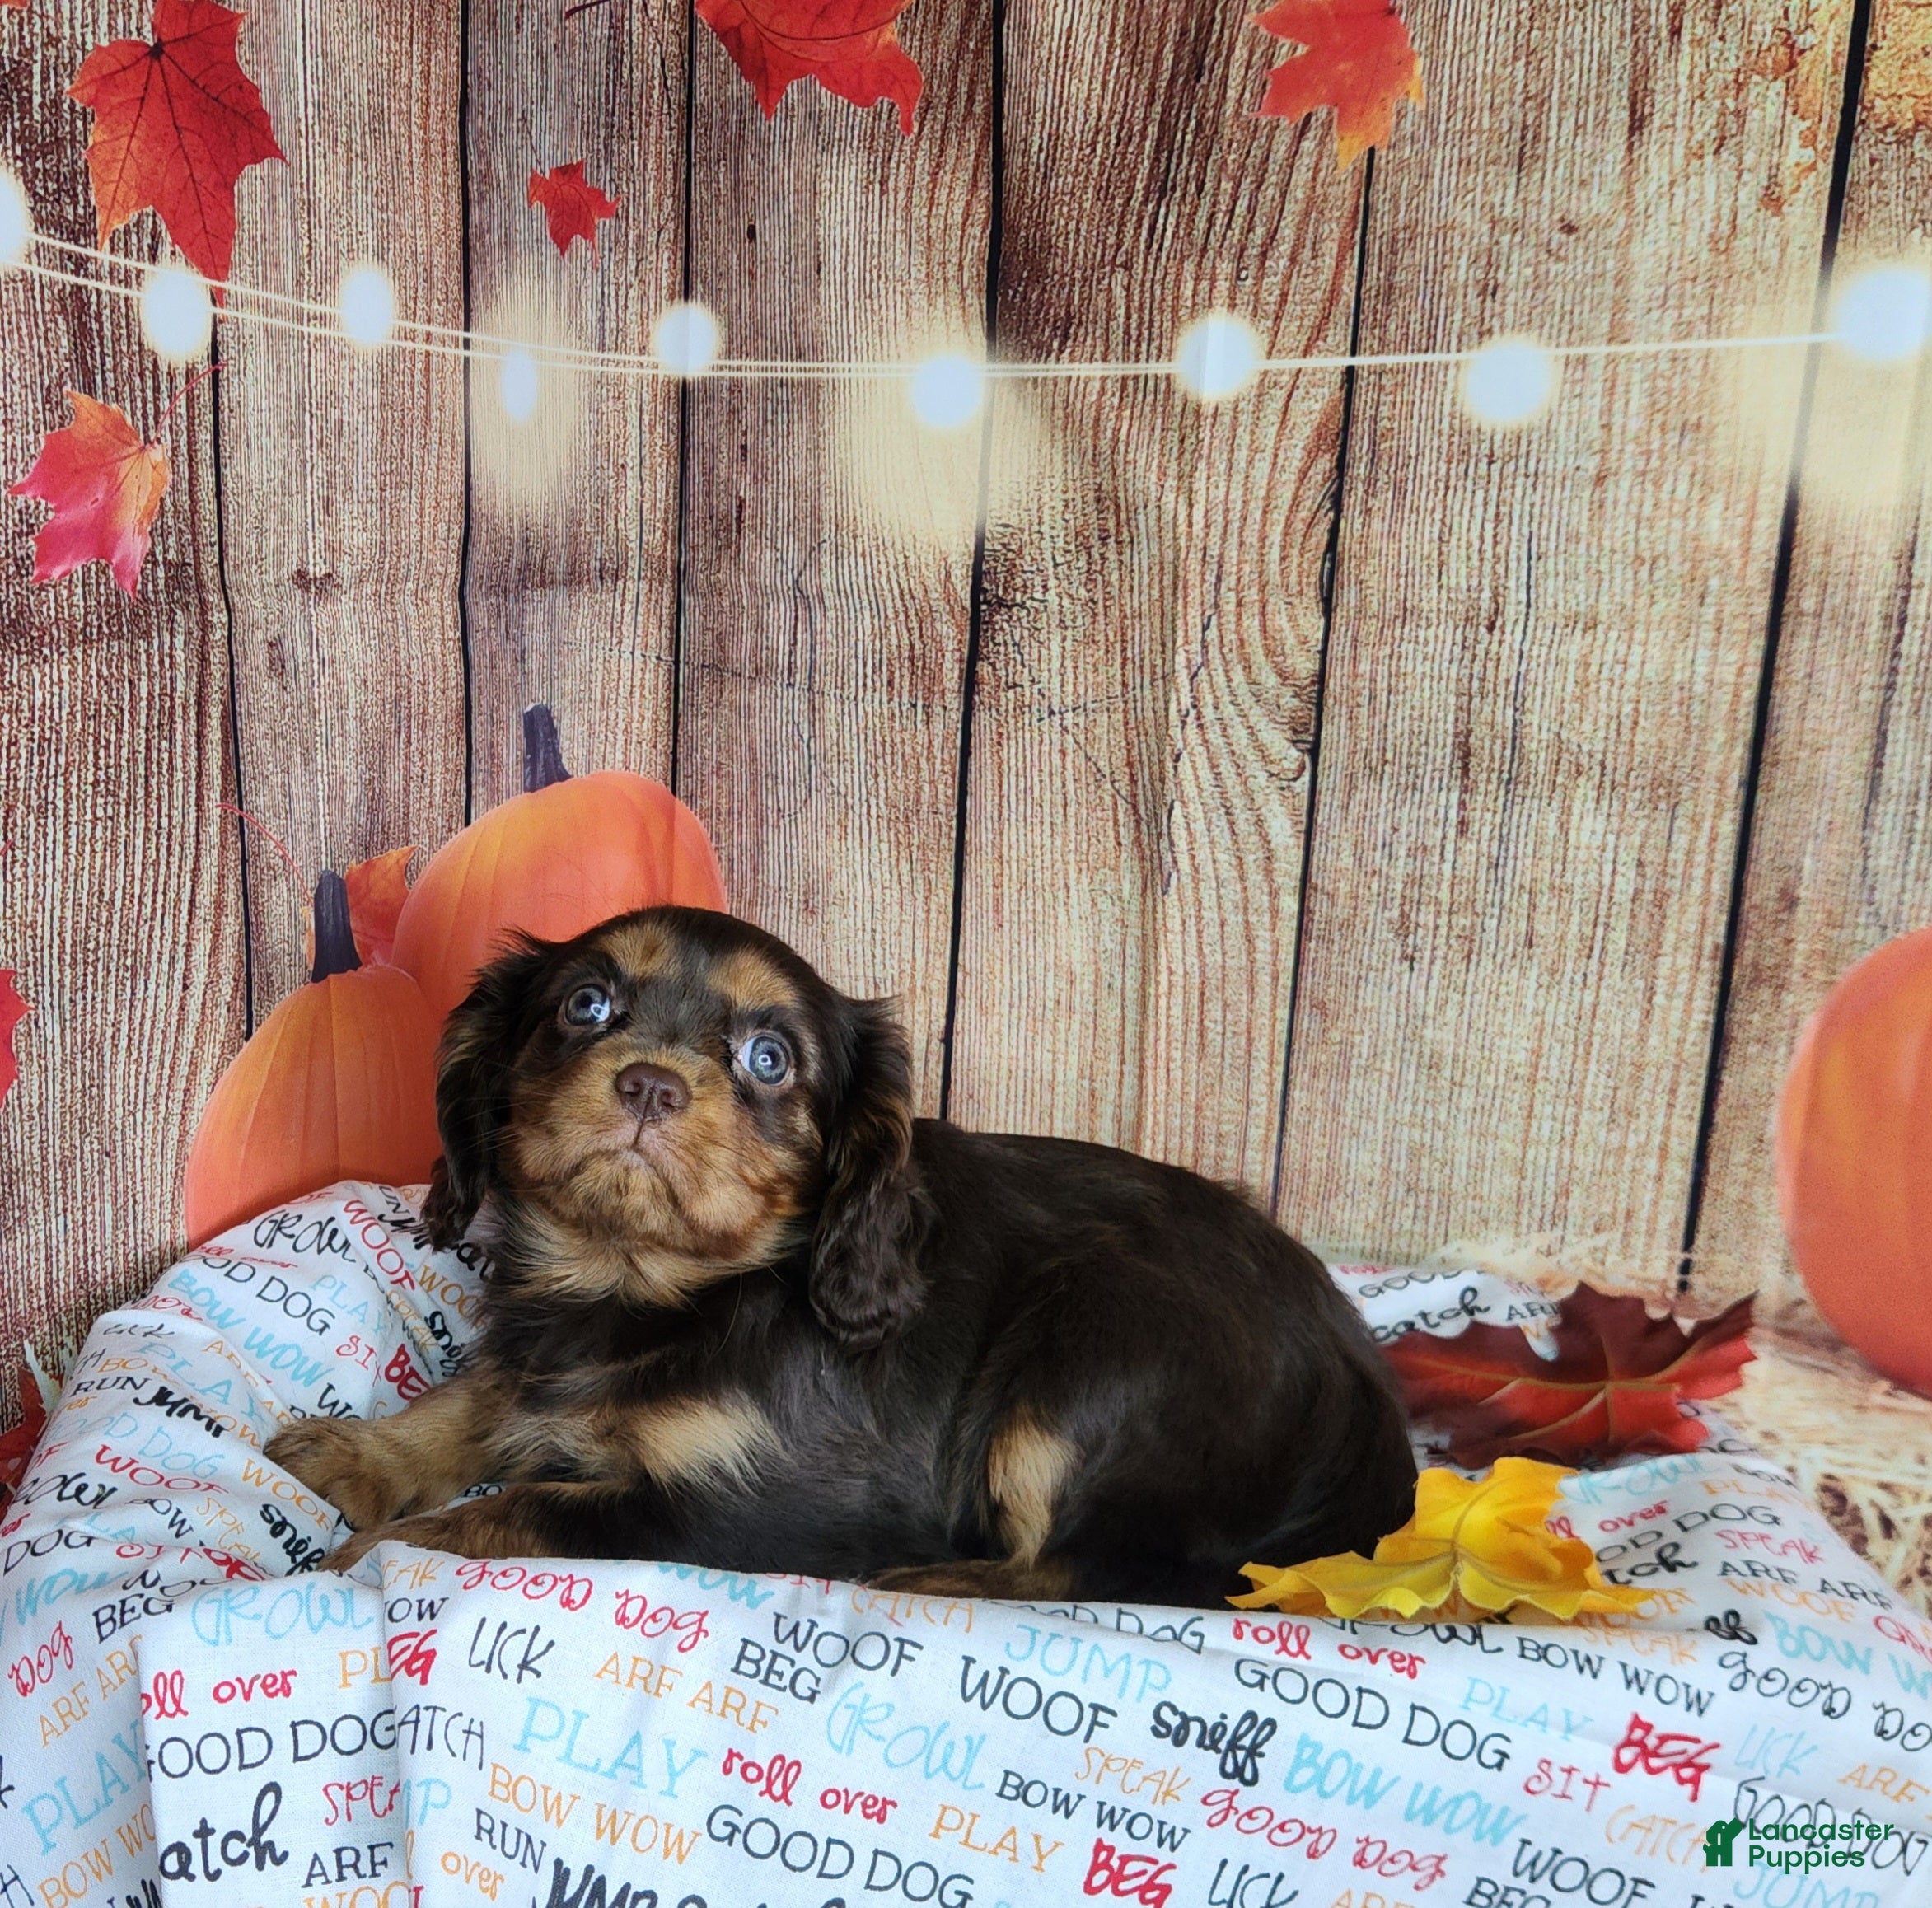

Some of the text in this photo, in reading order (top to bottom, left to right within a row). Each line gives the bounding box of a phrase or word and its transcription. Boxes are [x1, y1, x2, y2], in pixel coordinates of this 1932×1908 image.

[344, 1200, 415, 1291] WOOF
[168, 1269, 246, 1329] BOW
[244, 1327, 336, 1387] WOW
[255, 1276, 336, 1336] DOG
[70, 1377, 152, 1396] RUN
[385, 1343, 430, 1400] BE
[95, 1444, 229, 1494] WOOF
[138, 1426, 225, 1479] DOG
[3, 1529, 99, 1577] DOG
[1595, 1503, 1783, 1563] OD DOG
[1602, 1542, 1699, 1586] tch
[1714, 1529, 1824, 1564] SPEAK
[382, 1556, 445, 1591] EAK
[1718, 1560, 1893, 1610] ARF ARF
[92, 1593, 176, 1644] BEG
[190, 1581, 374, 1646] GROWL
[385, 1597, 449, 1624] OW
[773, 1611, 924, 1677] WOOF
[1763, 1609, 1873, 1676] BOW
[339, 1646, 391, 1689] PL
[387, 1629, 437, 1686] EG
[468, 1616, 555, 1684] LICK
[730, 1637, 821, 1705] BEG
[1004, 1624, 1172, 1703] JUMP
[1232, 1618, 1426, 1679] roll over
[1516, 1636, 1715, 1718] BOW WOW
[40, 1681, 89, 1748] ARF
[142, 1670, 297, 1720] oll over
[593, 1652, 779, 1733] ARF ARF
[961, 1655, 1118, 1743] WOOF
[1234, 1658, 1513, 1772] GOOD DOG
[1461, 1676, 1594, 1743] PLAY
[289, 1709, 397, 1764] DOG
[397, 1703, 484, 1771] ATCH
[512, 1696, 709, 1799] PLAY
[826, 1681, 987, 1790] GROWL
[1150, 1700, 1278, 1787] sniff
[1613, 1711, 1721, 1802] BEG
[1734, 1723, 1818, 1778] LICK
[20, 1719, 147, 1856] PLAY
[322, 1775, 400, 1826] SPE
[722, 1747, 897, 1824] roll over
[1074, 1747, 1191, 1805] SPEAK
[1283, 1732, 1528, 1847] BOW WOW
[1838, 1763, 1931, 1803] ARF
[160, 1781, 289, 1882] atch
[474, 1807, 547, 1874] RUN
[488, 1761, 581, 1829] BOW
[595, 1803, 702, 1865] WOW
[928, 1803, 1064, 1873] PLAY
[995, 1769, 1191, 1853] BOW WOW
[38, 1838, 113, 1908] BOW
[116, 1803, 157, 1859] WO
[301, 1842, 394, 1888] ARF
[440, 1851, 504, 1901] over
[706, 1804, 975, 1908] GOOD DOG
[1083, 1837, 1177, 1908] BEG
[1512, 1837, 1656, 1908] WOOF
